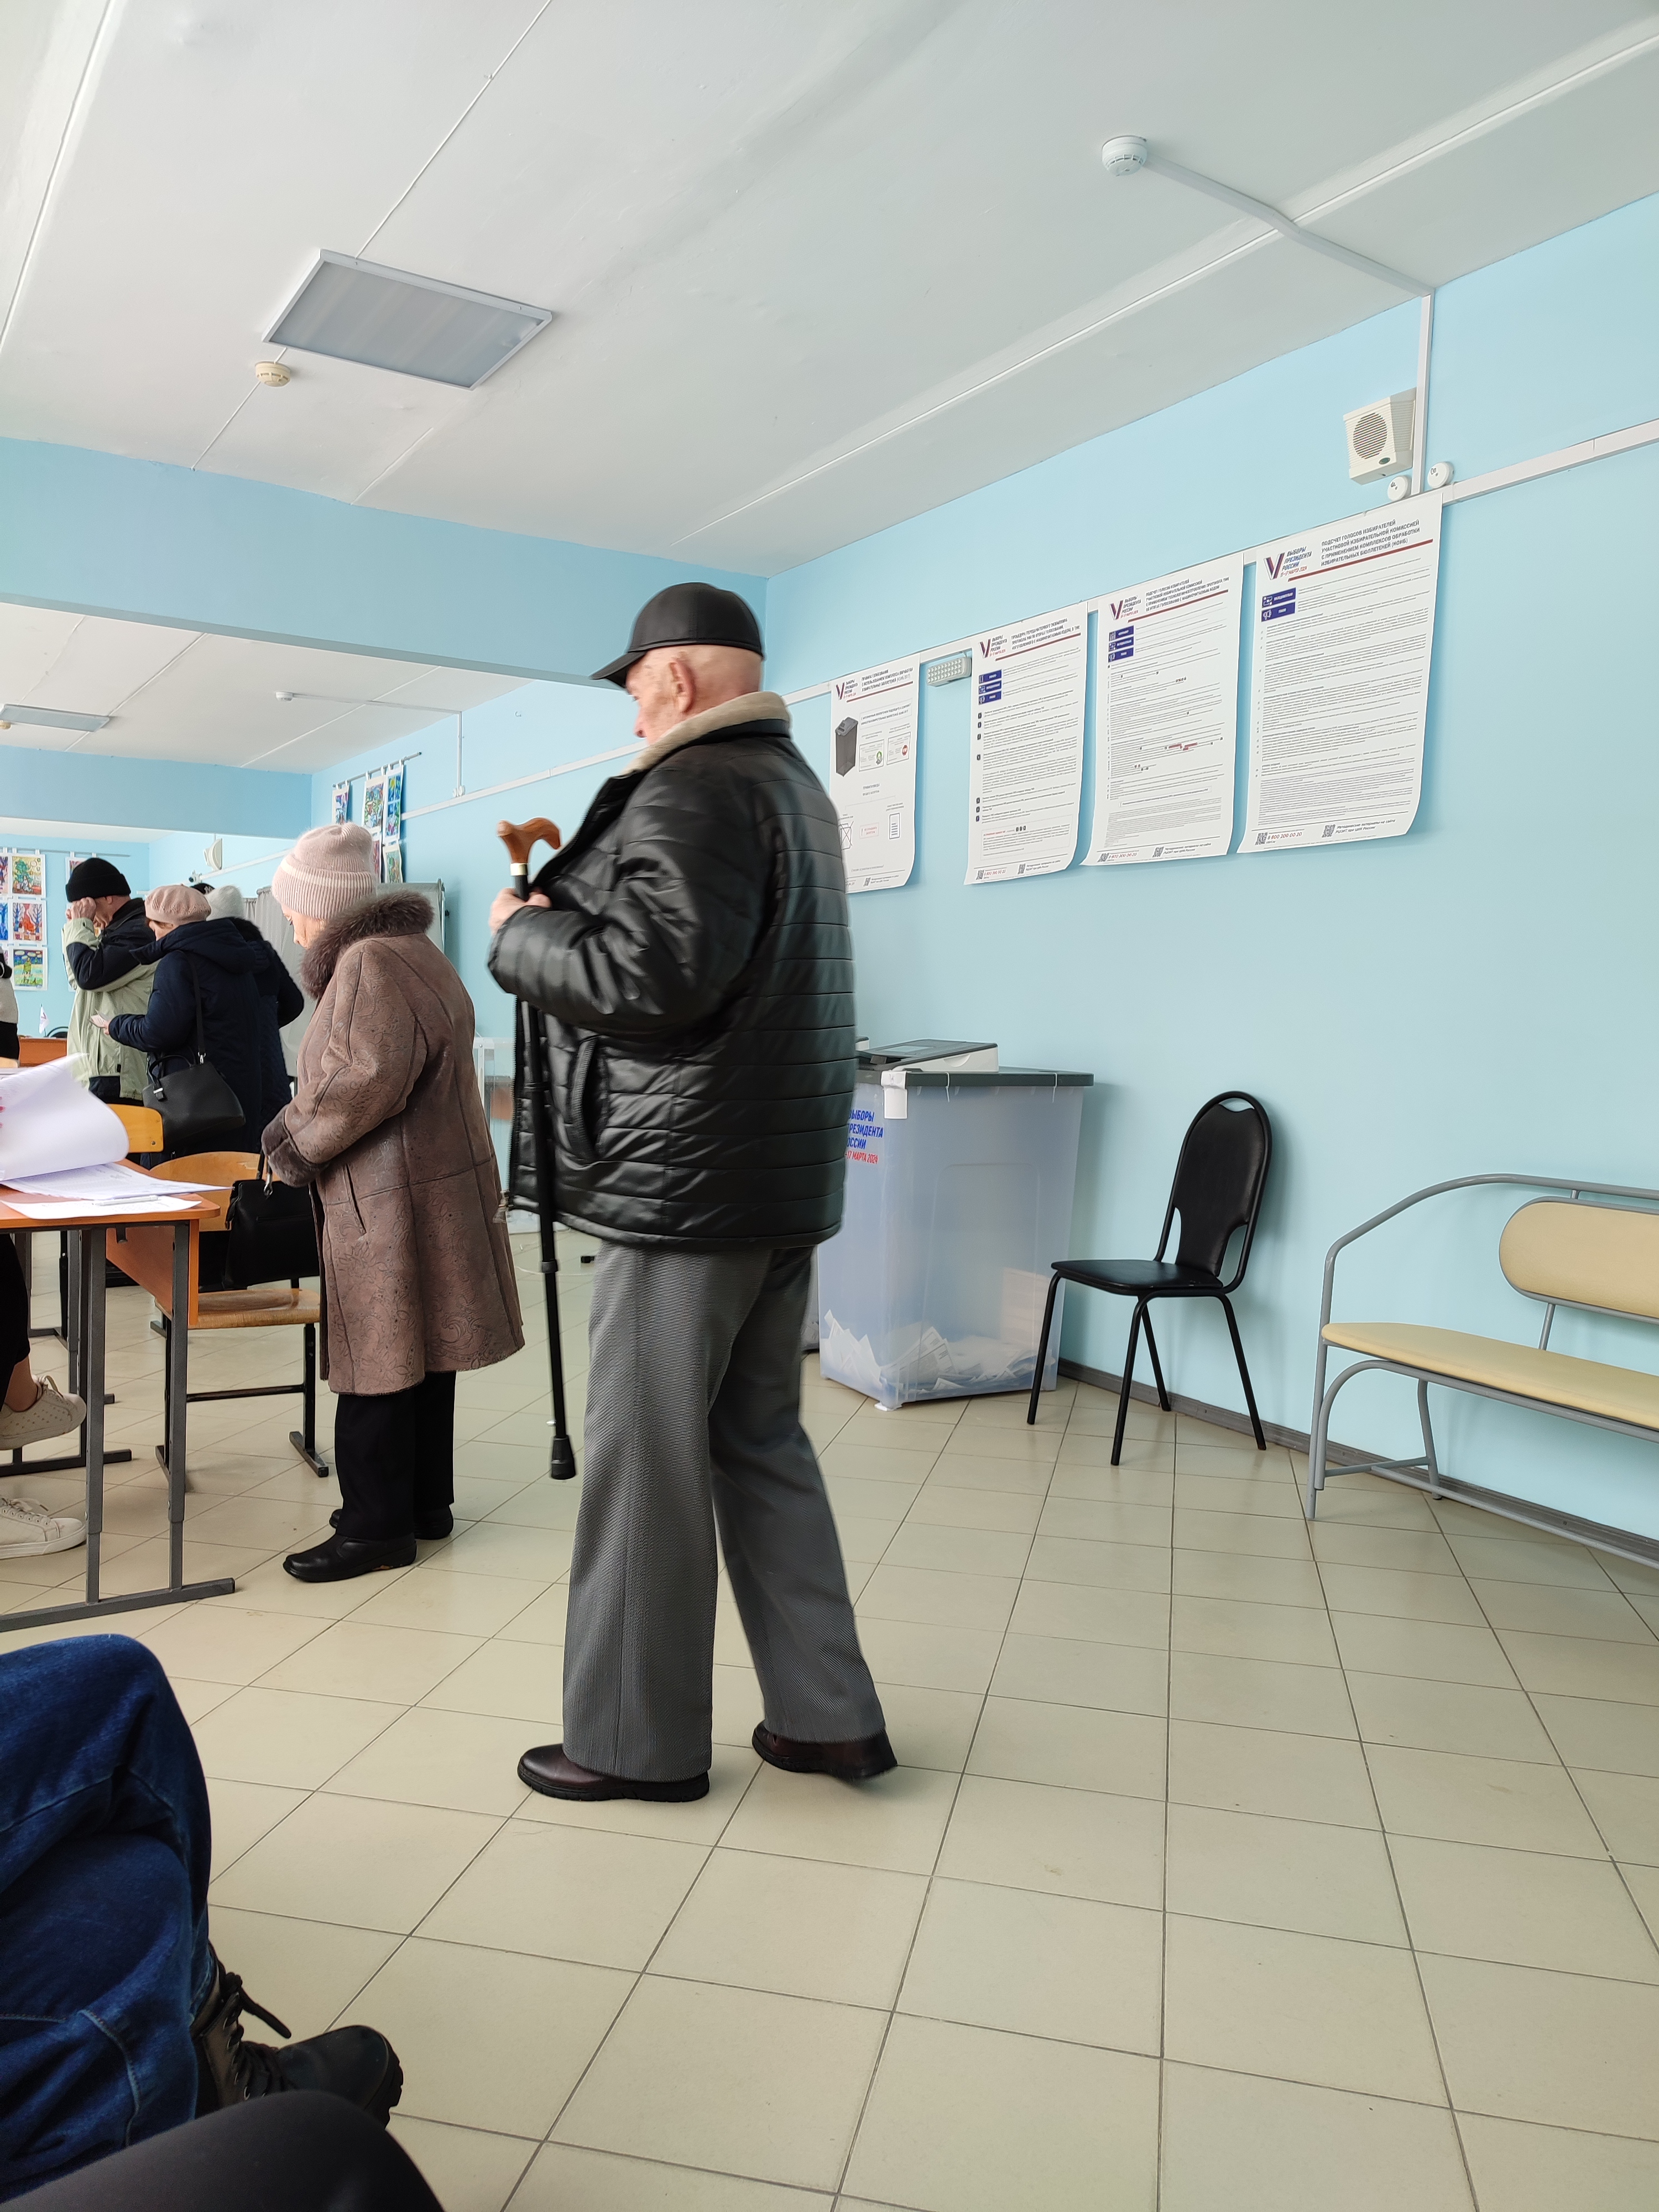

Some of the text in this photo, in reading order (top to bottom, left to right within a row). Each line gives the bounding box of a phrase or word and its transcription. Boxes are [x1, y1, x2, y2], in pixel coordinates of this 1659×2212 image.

[1321, 519, 1396, 546] ПОДСЧЕТ ГОЛОСОВ ИЗБИРАТЕЛЕЙ
[1321, 519, 1420, 553] УЧАСТКОВОЙ ИЗБИРАТЕЛЬНОЙ КОМИССИЕЙ
[1325, 546, 1359, 559] ПРИМЕНЕНИЕМ
[1360, 535, 1391, 549] КОМПЛЕКСОВ
[1392, 527, 1420, 540] ОБРАБОТКИ
[1284, 551, 1312, 564] ПРЕЗИДЕНТА
[1287, 546, 1307, 557] ВЫБОРЫ
[1321, 551, 1359, 566] ИЗБИРАТЕЛЬНЫХ
[1360, 542, 1391, 556] БЮЛЛЕТЕНЕЙ
[1282, 561, 1300, 571] РОССИИ
[847, 1136, 867, 1150] ОССИИ
[852, 1151, 867, 1162] МАРТА
